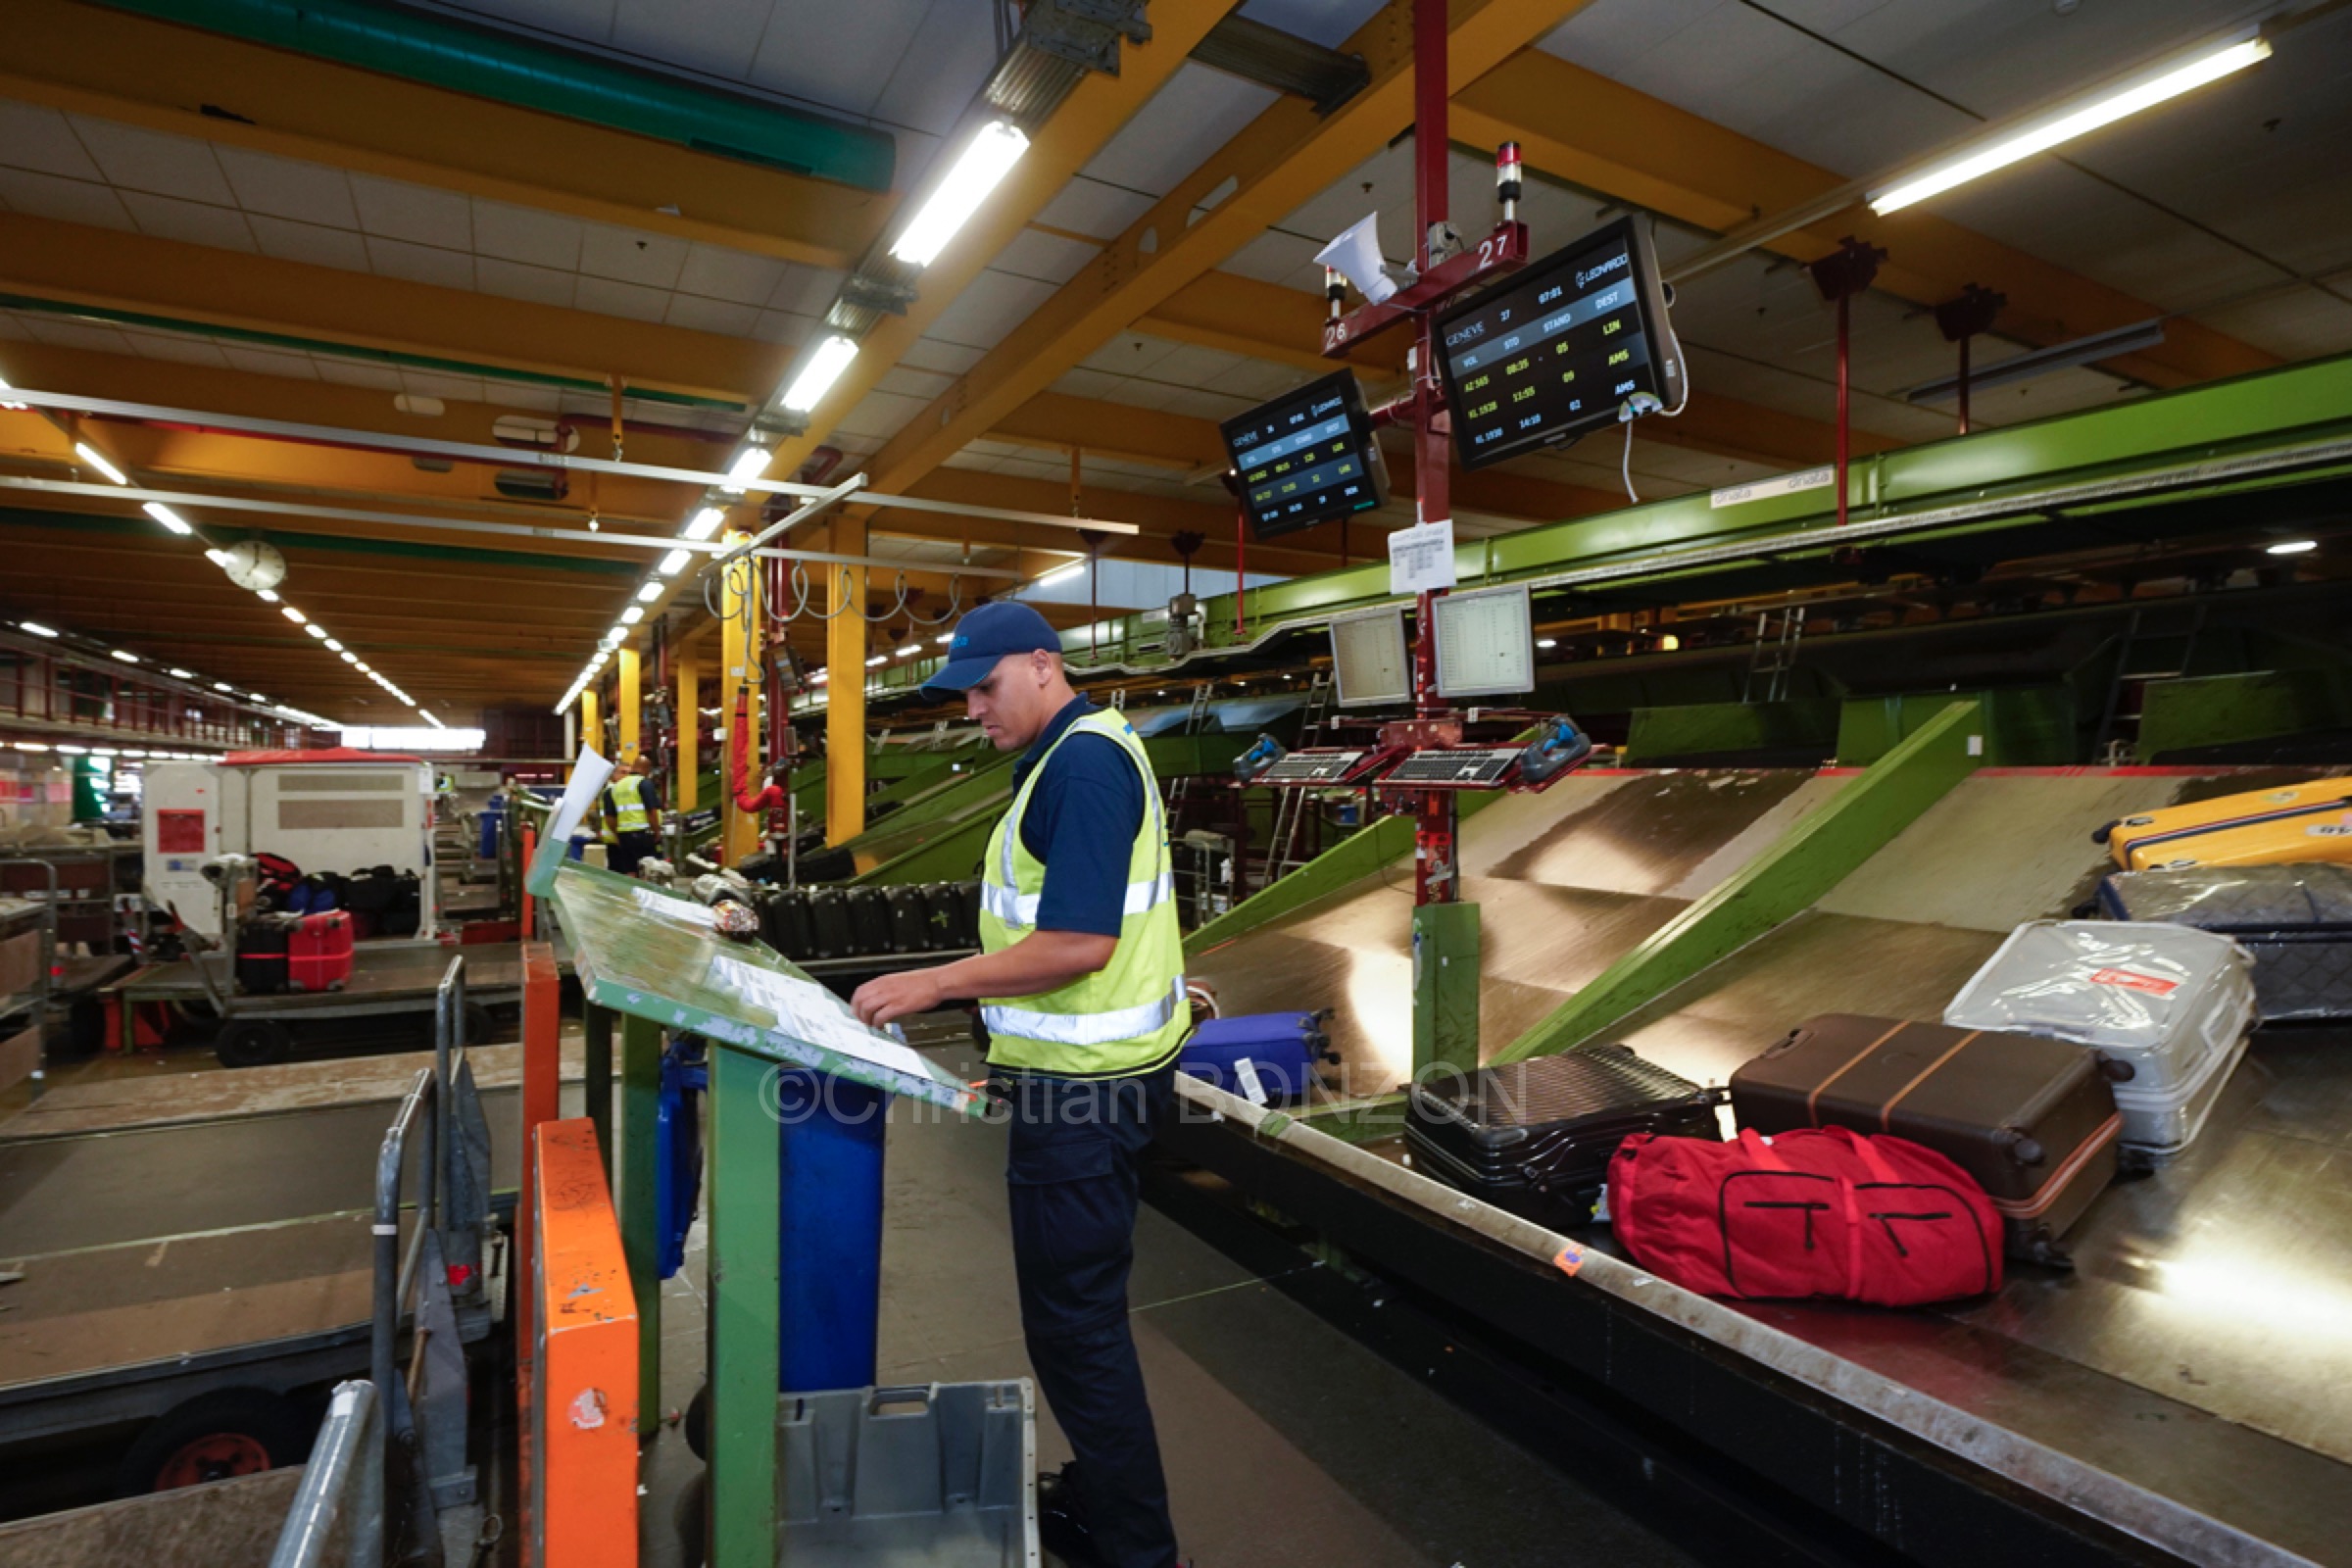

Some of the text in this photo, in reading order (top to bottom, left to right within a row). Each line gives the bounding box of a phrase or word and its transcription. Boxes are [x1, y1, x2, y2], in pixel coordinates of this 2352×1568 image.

[1478, 234, 1508, 270] 27
[1544, 314, 1572, 334] STAND
[1595, 292, 1619, 311] DEST
[1325, 322, 1347, 351] 26
[1446, 321, 1486, 347] GENEVE
[1603, 319, 1622, 336] LIN
[1609, 349, 1630, 367] AMS
